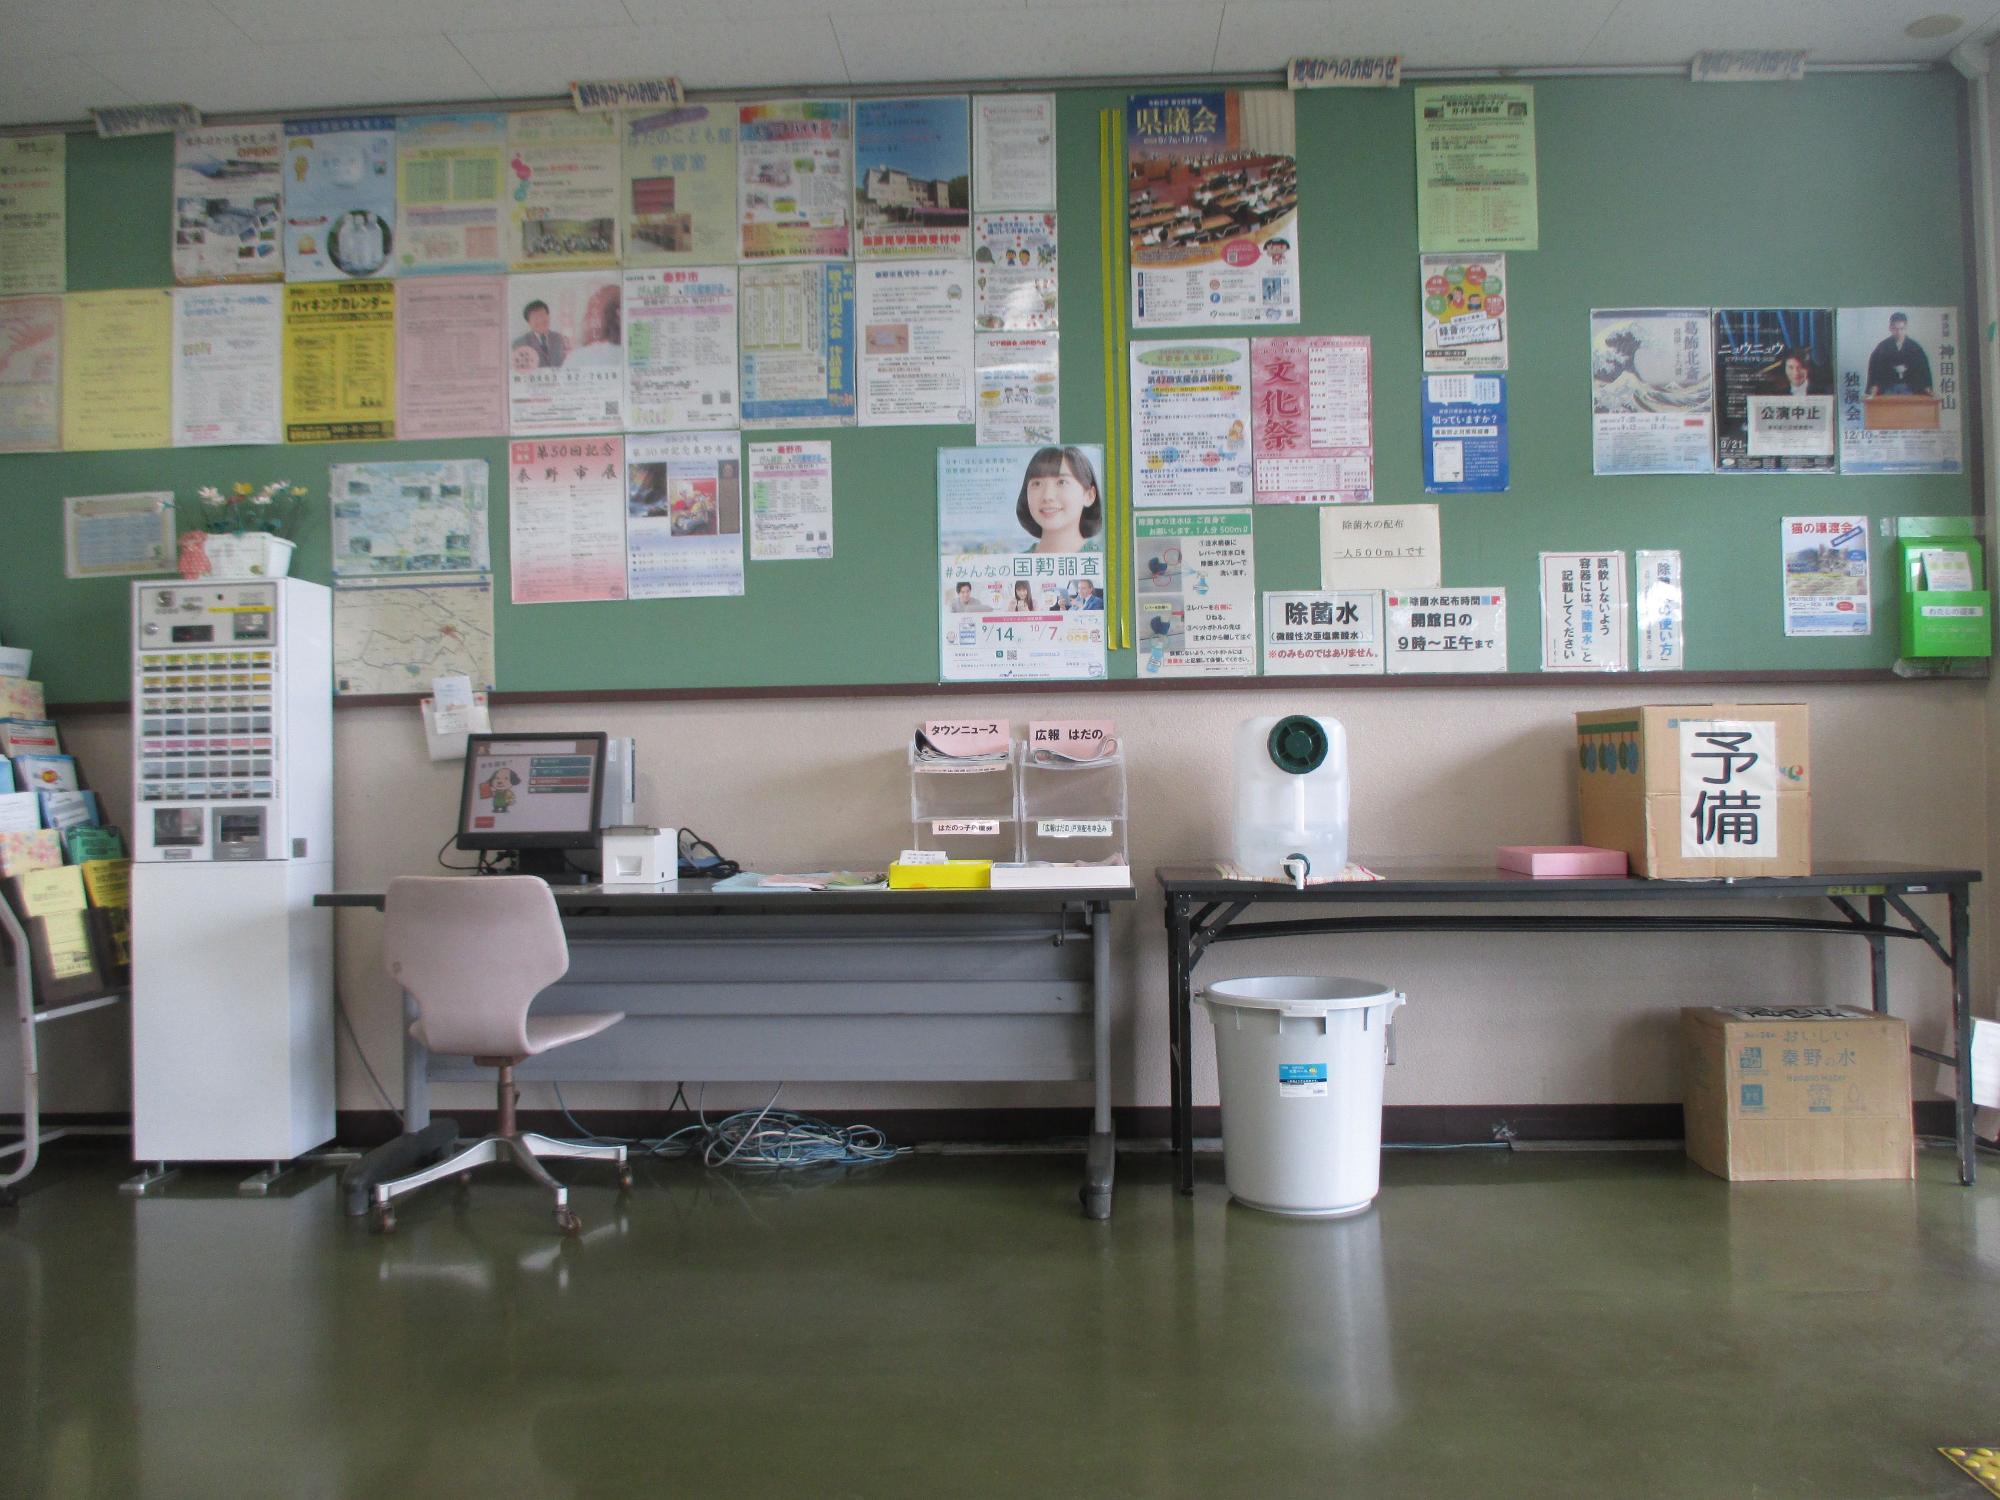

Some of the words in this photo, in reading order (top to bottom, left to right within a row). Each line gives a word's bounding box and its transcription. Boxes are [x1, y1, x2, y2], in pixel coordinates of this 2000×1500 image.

[1135, 106, 1219, 136] 県議会
[291, 296, 391, 313] ハイキングカレンダー
[1718, 341, 1785, 355] ニュウニュウ
[1939, 344, 1956, 411] 神田伯山
[1260, 356, 1304, 451] 文化祭
[1843, 371, 1861, 422] 独演会
[1760, 405, 1821, 421] 公演中止
[537, 442, 615, 460] 第50回記念
[1720, 439, 1743, 449] 9/21
[516, 463, 618, 484] 秦野市展
[1342, 519, 1405, 530] 除菌水の配布
[1791, 522, 1854, 535] 猫の譲渡会
[1409, 596, 1481, 607] 除菌水配布時間
[1597, 558, 1610, 636] 誤飲しないよう
[1285, 601, 1360, 626] 除菌水
[1561, 569, 1575, 660] 記載してください
[1579, 558, 1593, 663] 容器には「除菌水」と
[1411, 613, 1473, 628] 開館日の
[931, 724, 999, 736] タウンニュース
[1035, 728, 1060, 741] 広報
[1068, 728, 1104, 741] はだの
[1690, 731, 1761, 845] 予備
[1783, 1030, 1850, 1043] おいしい
[1781, 1047, 1857, 1068] 秦野の水
